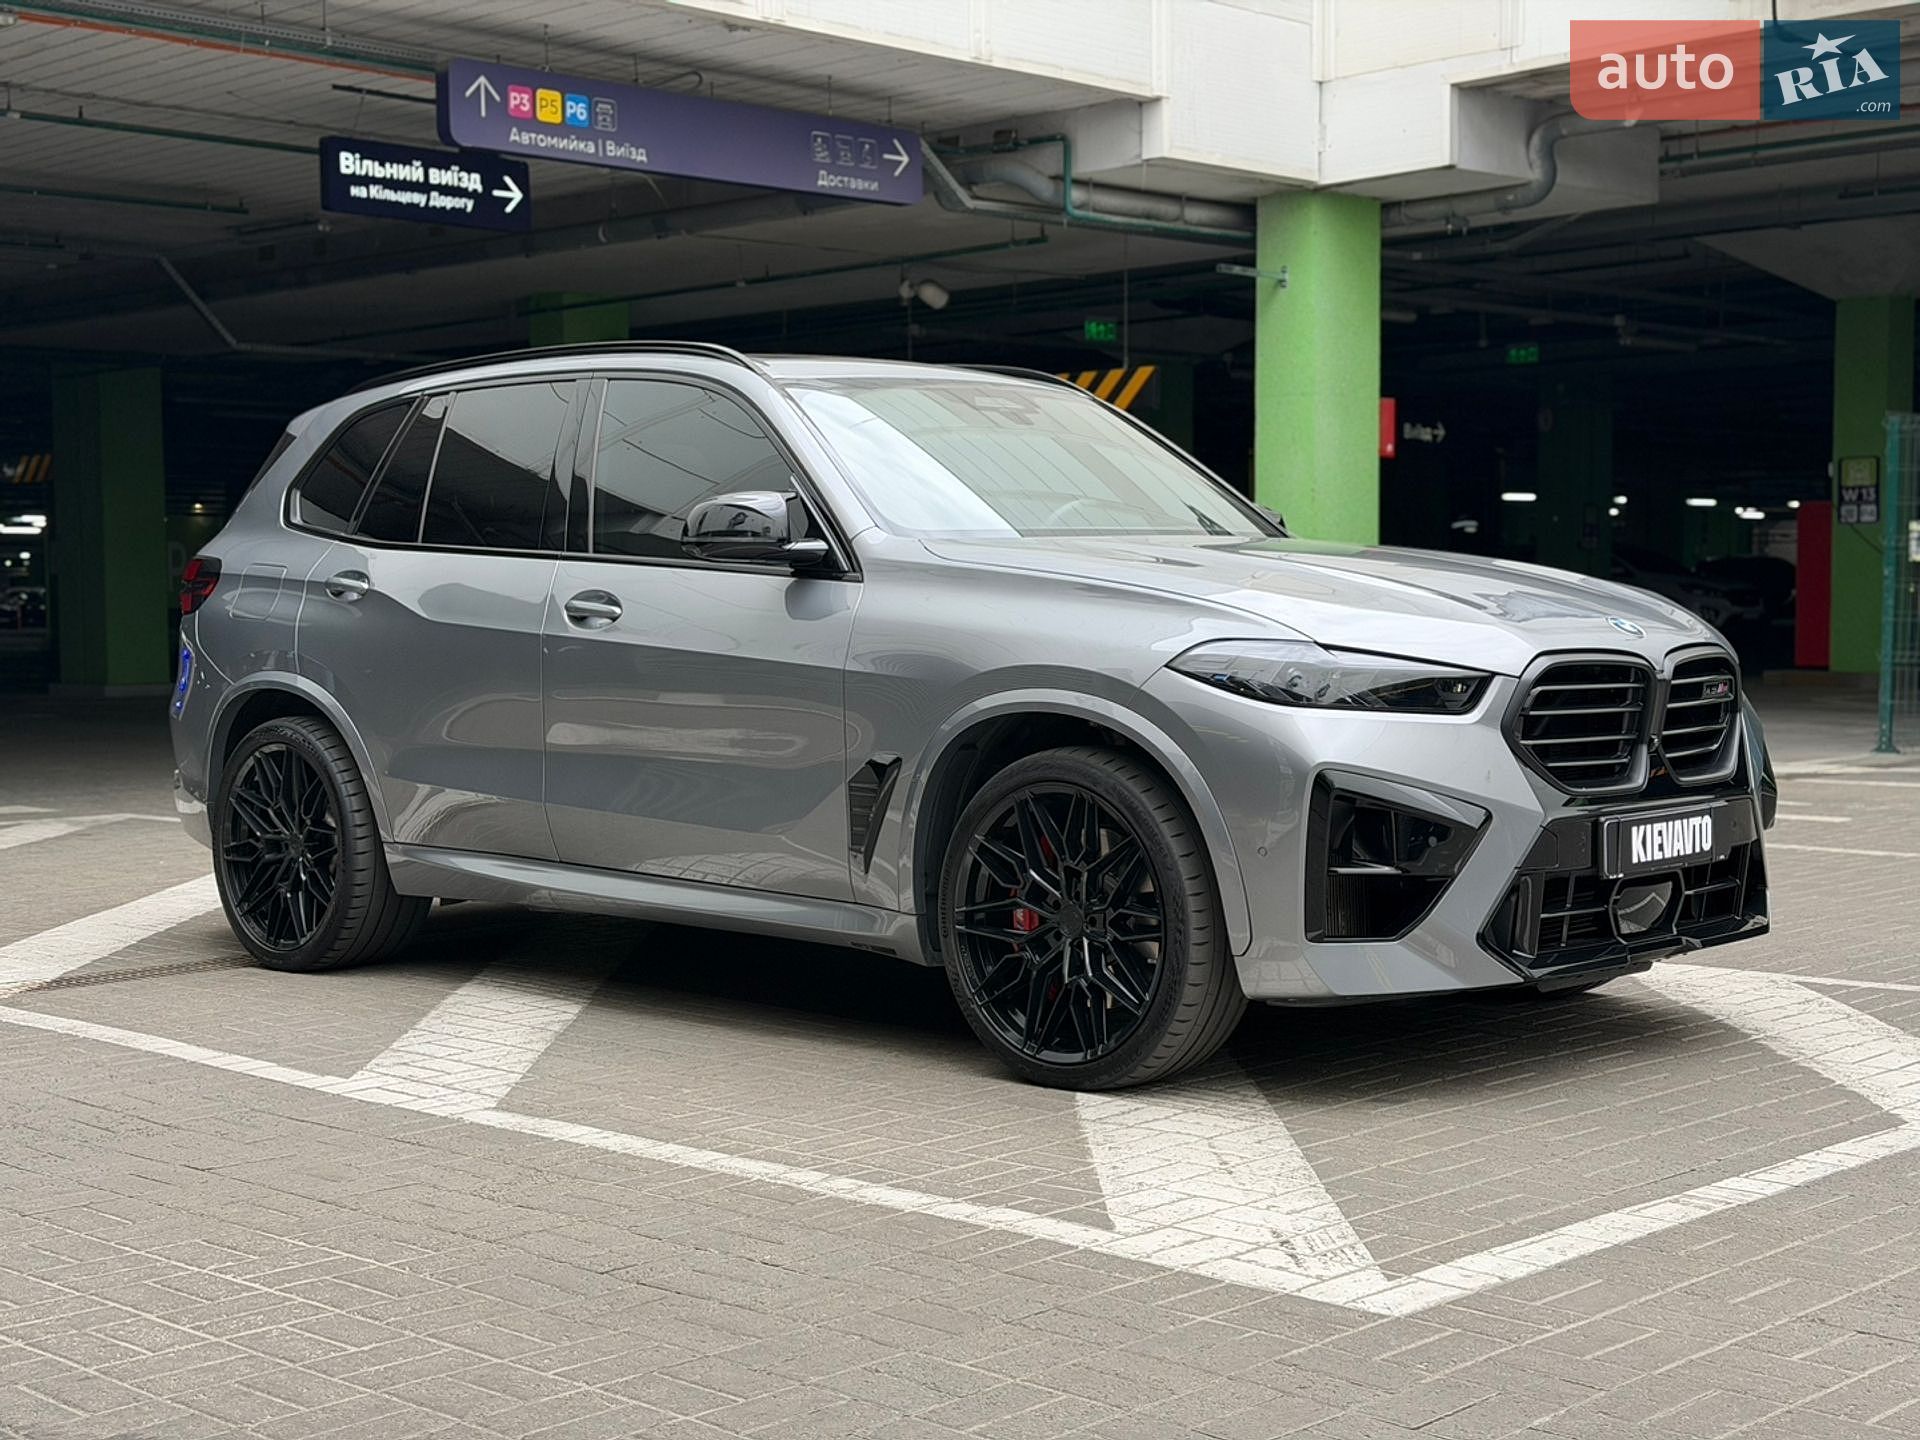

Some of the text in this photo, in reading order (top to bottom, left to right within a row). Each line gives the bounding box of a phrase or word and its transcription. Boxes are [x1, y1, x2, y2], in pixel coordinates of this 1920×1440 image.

[510, 92, 588, 121] P3 P5 P6
[509, 126, 596, 154] Автомийка
[606, 141, 648, 163] Виїзд
[338, 150, 483, 194] Вільний виїзд
[817, 169, 879, 192] Доставки
[350, 184, 475, 213] на Кільцеву Дорогу
[1631, 814, 1712, 864] KIEVAVTO
